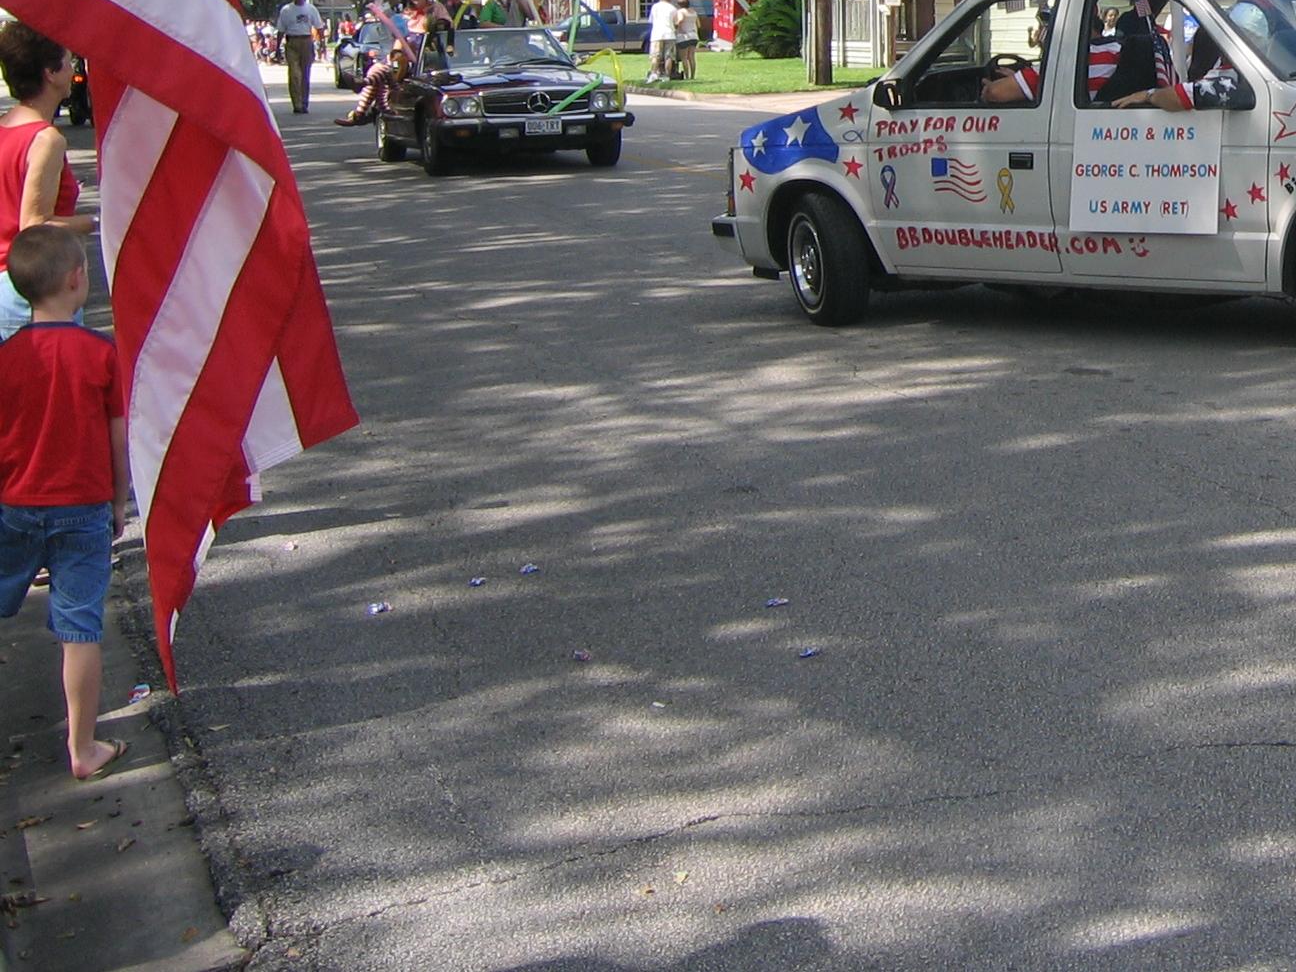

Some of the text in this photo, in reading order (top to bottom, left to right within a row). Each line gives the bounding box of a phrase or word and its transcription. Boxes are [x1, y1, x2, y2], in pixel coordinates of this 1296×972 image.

[875, 115, 1000, 138] PRAY FOR OUR
[1092, 127, 1195, 141] MAJOR & MRS
[874, 134, 948, 162] TROOPS
[1075, 164, 1217, 178] GEORGE C. THOMPSON
[1089, 200, 1189, 218] US ARMY (RET)
